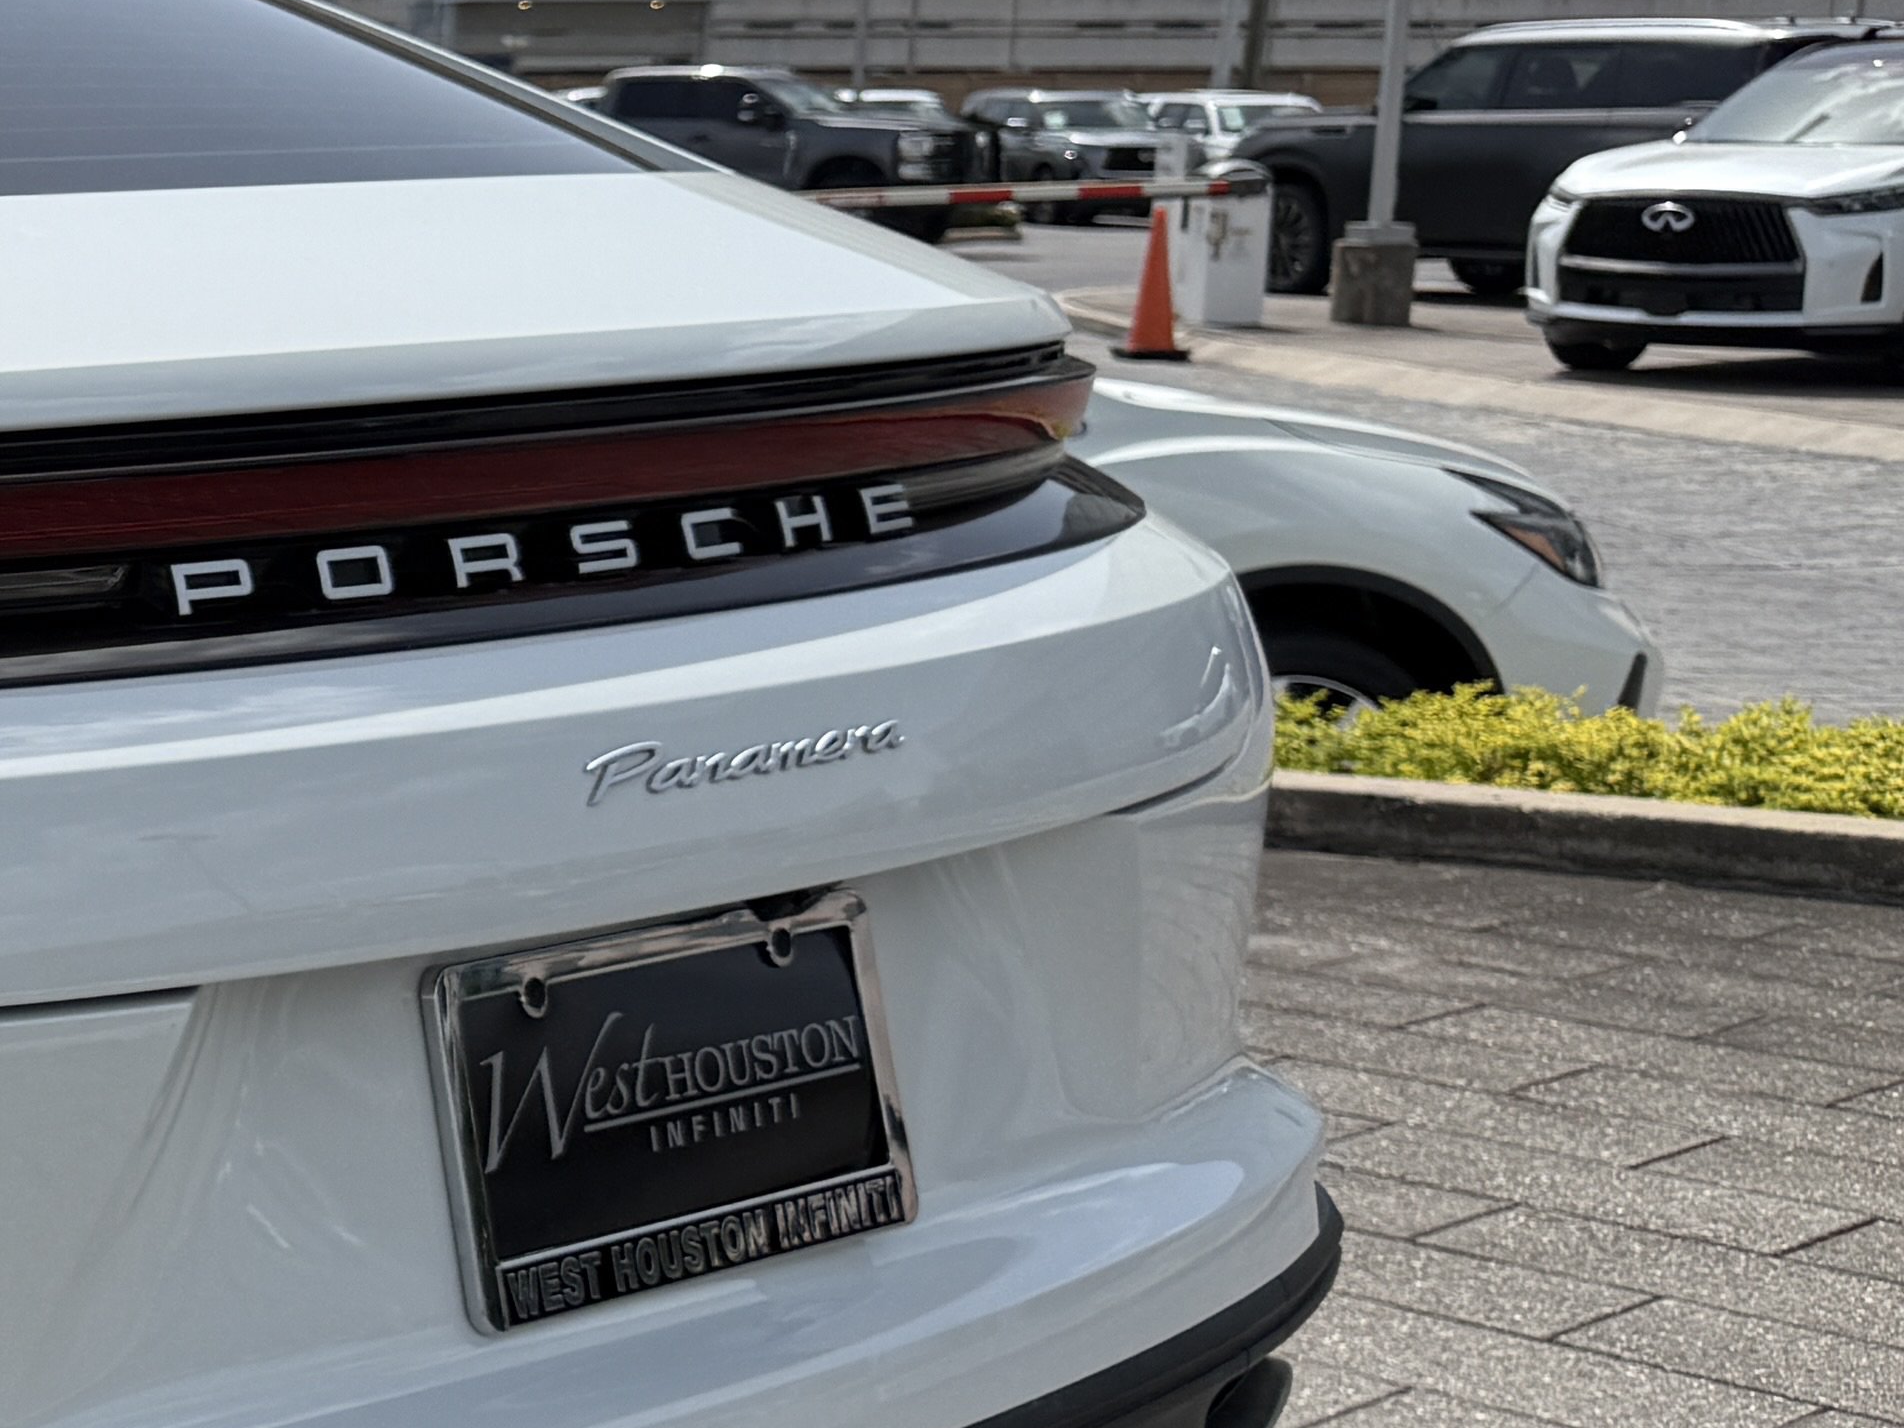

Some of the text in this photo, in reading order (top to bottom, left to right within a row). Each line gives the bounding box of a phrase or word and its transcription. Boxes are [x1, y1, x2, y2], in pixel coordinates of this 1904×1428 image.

[170, 483, 917, 616] PORSCHE
[585, 718, 907, 809] Panamera
[479, 1011, 860, 1174] West HOUSTON
[649, 1092, 800, 1153] INFINITI
[507, 1173, 903, 1320] WEST HOUSTON INFINITI
